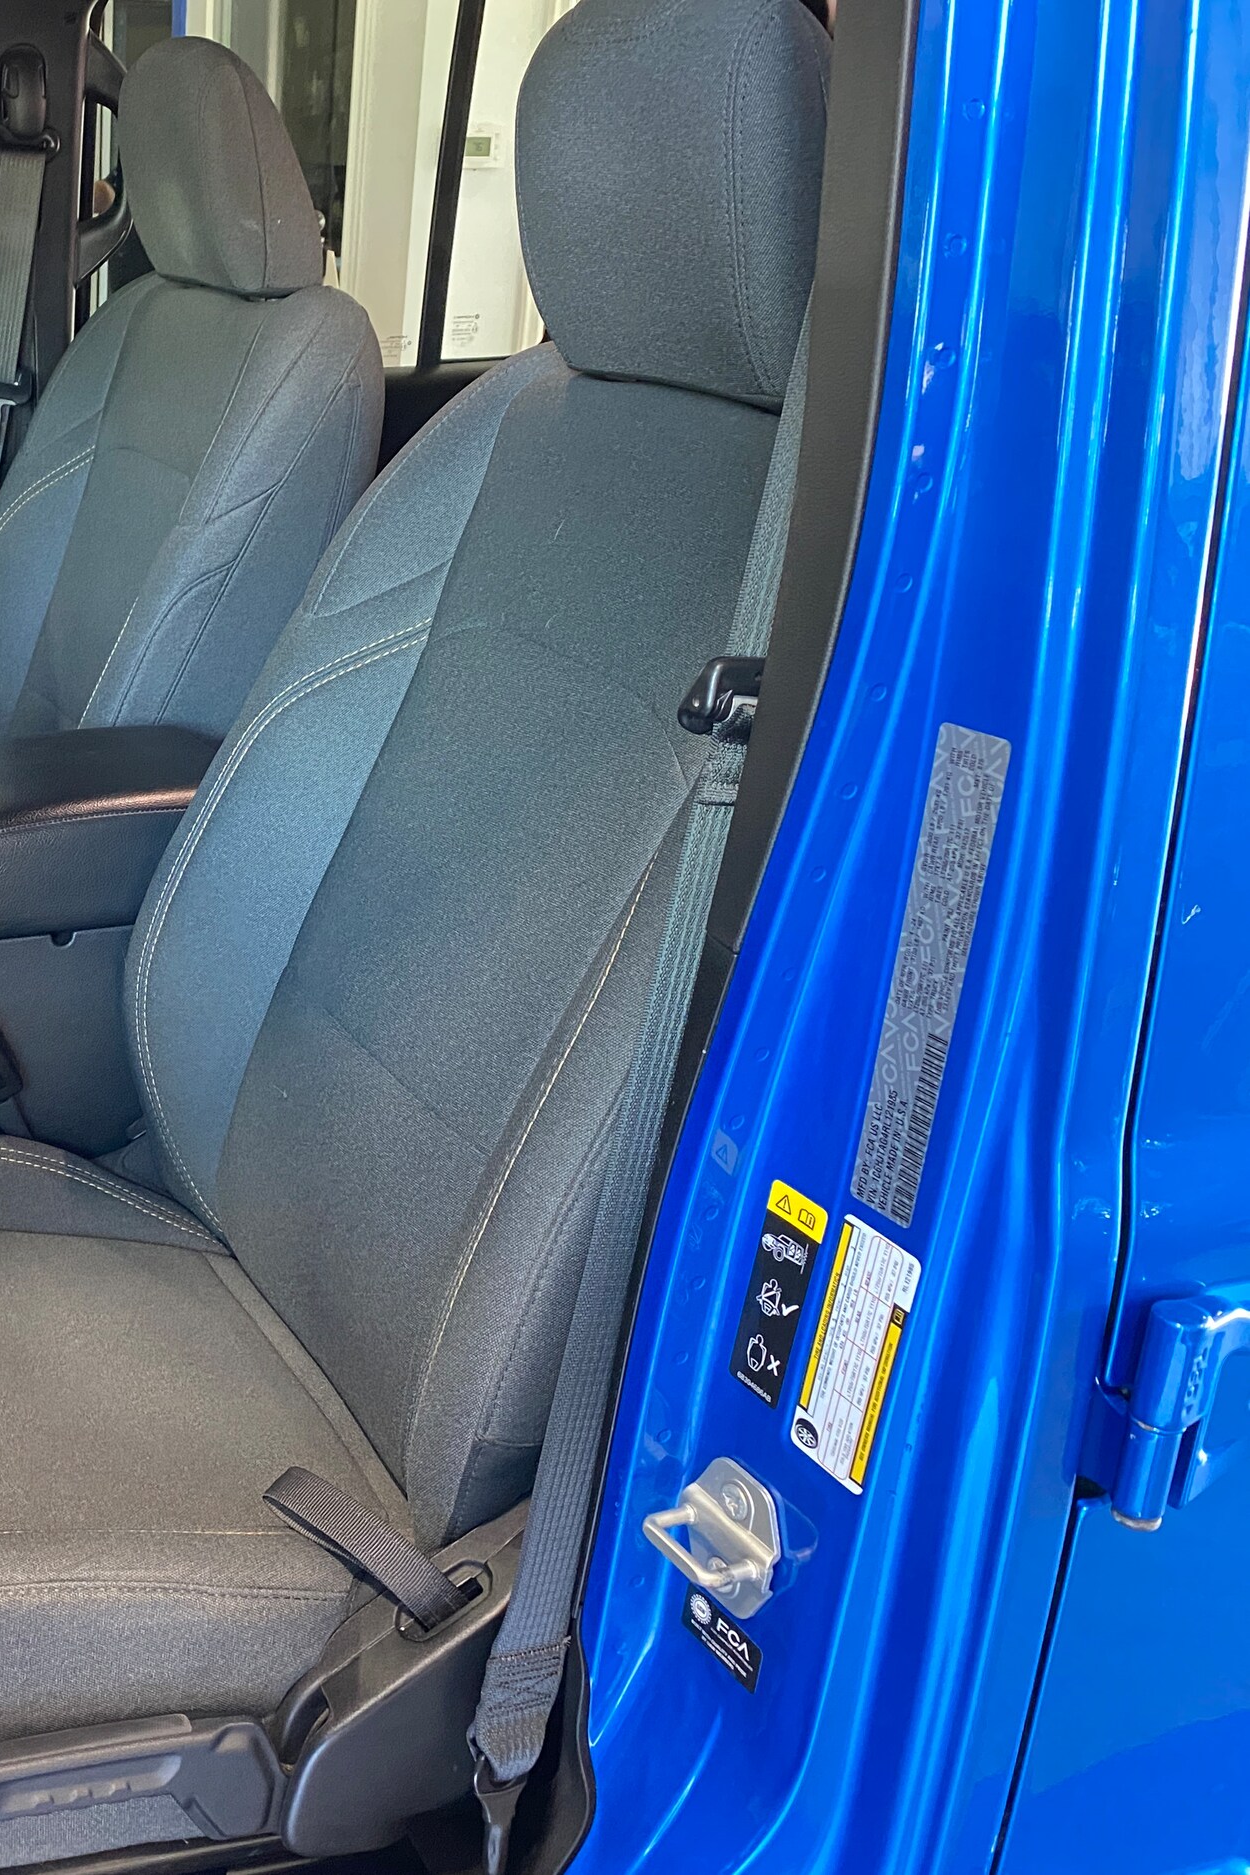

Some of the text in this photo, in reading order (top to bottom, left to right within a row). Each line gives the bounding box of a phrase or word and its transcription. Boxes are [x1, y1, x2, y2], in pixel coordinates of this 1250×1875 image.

[871, 1101, 883, 1121] LLC
[868, 1121, 878, 1136] US
[864, 1137, 875, 1157] FCA
[856, 1175, 867, 1198] MFD
[877, 1171, 892, 1211] VEHICLE
[885, 1142, 898, 1171] MADE
[716, 1617, 749, 1661] FCA
